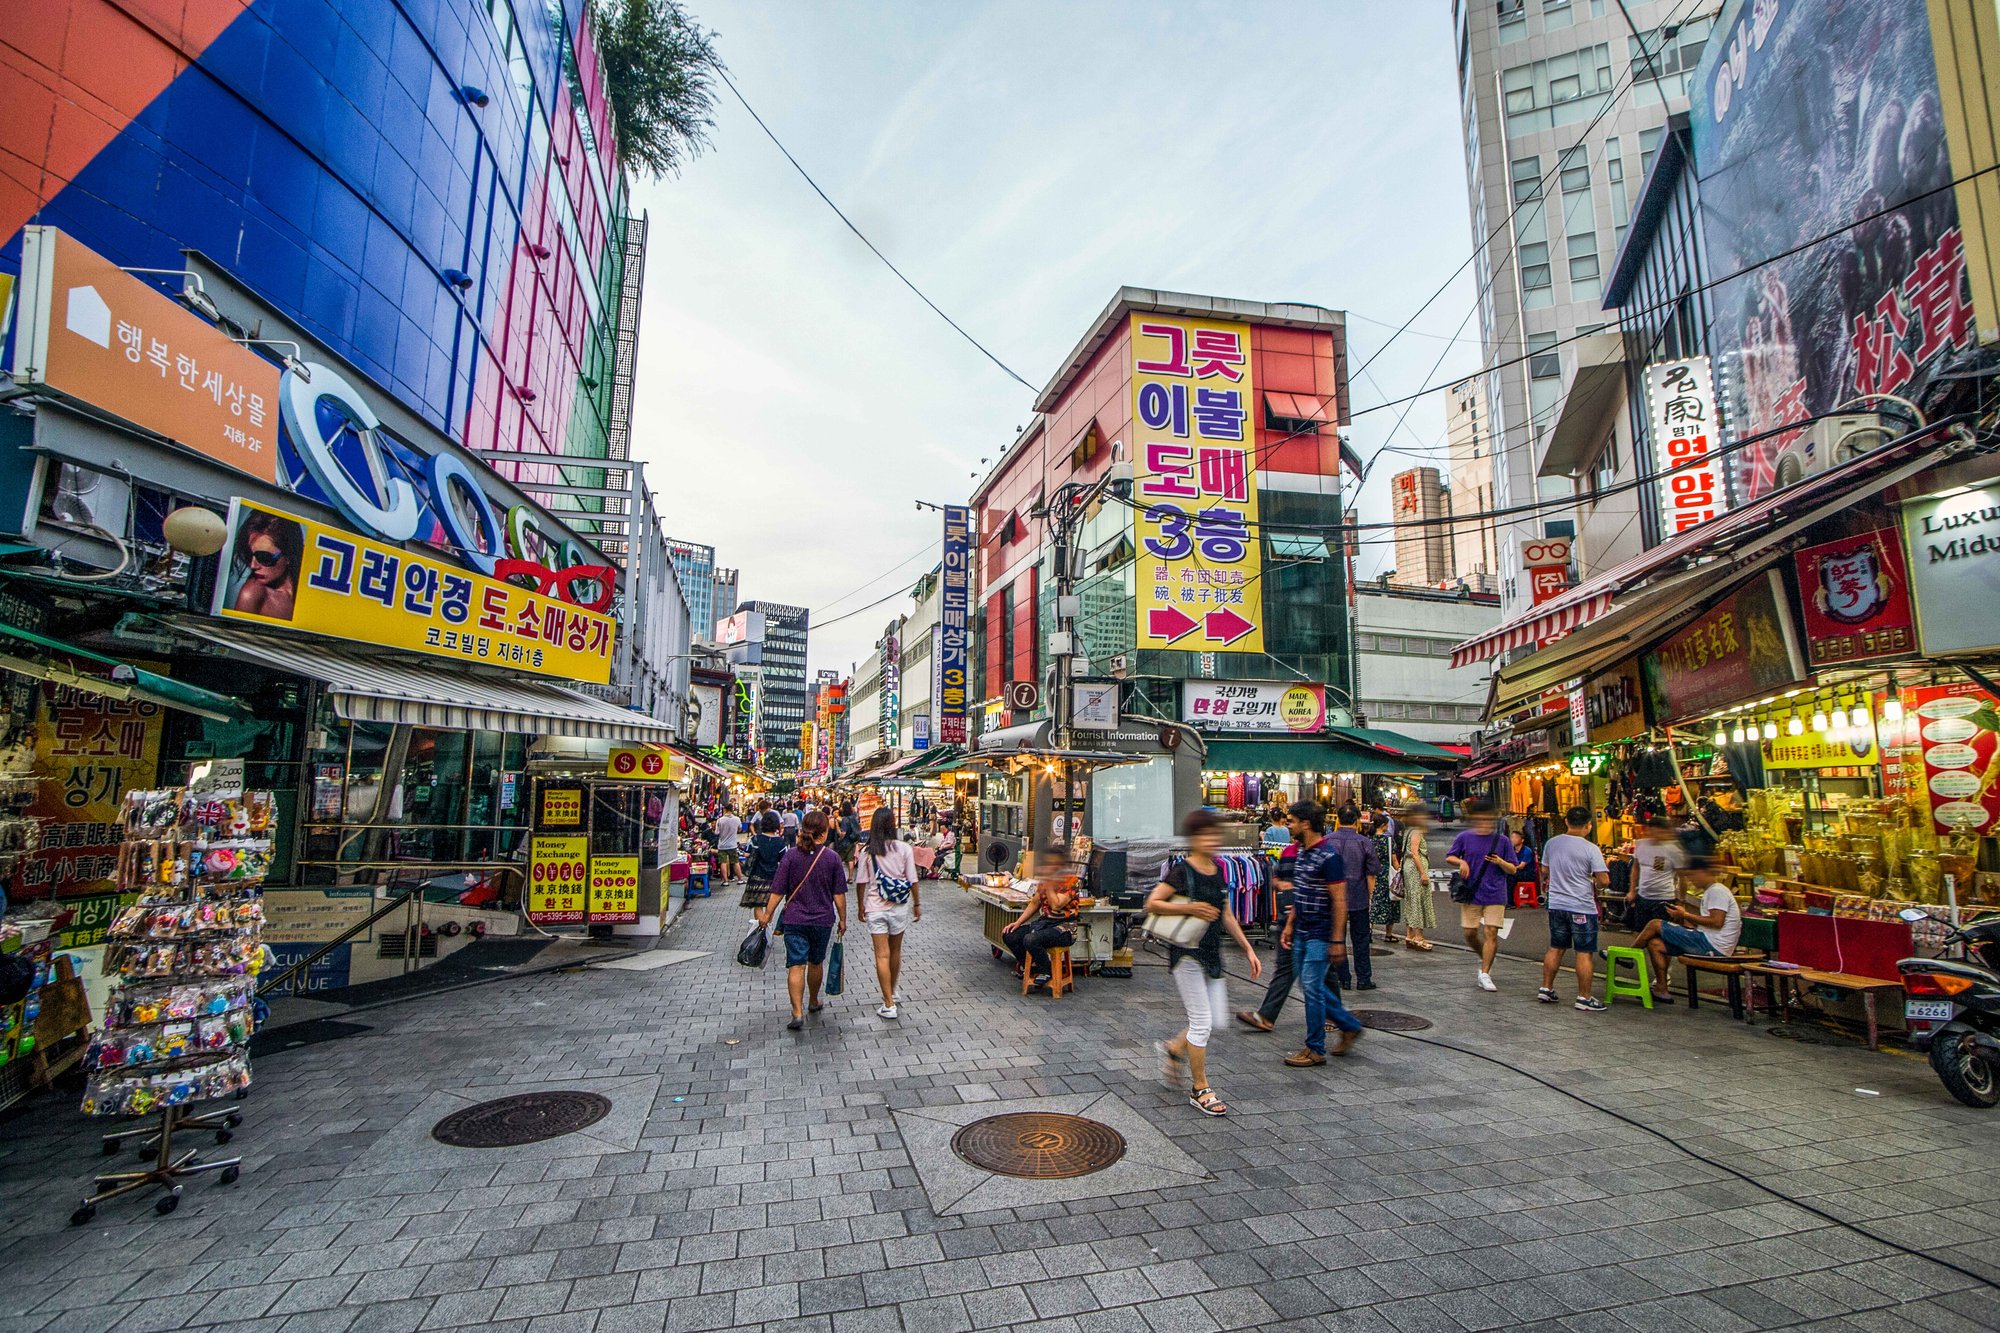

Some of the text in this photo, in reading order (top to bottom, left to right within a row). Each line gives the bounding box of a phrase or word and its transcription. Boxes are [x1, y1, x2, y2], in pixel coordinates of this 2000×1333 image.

[1137, 321, 1245, 383] 그릇
[1137, 382, 1246, 441] 이불
[1661, 365, 1706, 426] 名家
[223, 423, 263, 453] 지하 2F
[1672, 424, 1701, 437] 명가
[1142, 444, 1250, 502] 도매
[1143, 502, 1252, 563] 3층
[308, 533, 611, 659] 고려안경 도.소매상가
[943, 592, 967, 666] 도매상가
[424, 627, 544, 668] 코코빌딩 지하1층
[943, 668, 966, 707] 3층
[1215, 686, 1258, 698] 국산가방
[1232, 701, 1277, 716] 균일가!
[51, 717, 147, 760] 도.소매
[1071, 730, 1159, 741] Tourist Information
[64, 765, 123, 808] 상가
[536, 841, 567, 849] Money
[536, 851, 580, 859] Exchange
[531, 912, 583, 921] 010-5395-5680
[591, 913, 636, 921] 010-5395-5680
[271, 952, 331, 967] CUVUE
[1917, 1007, 1947, 1017] 6266
